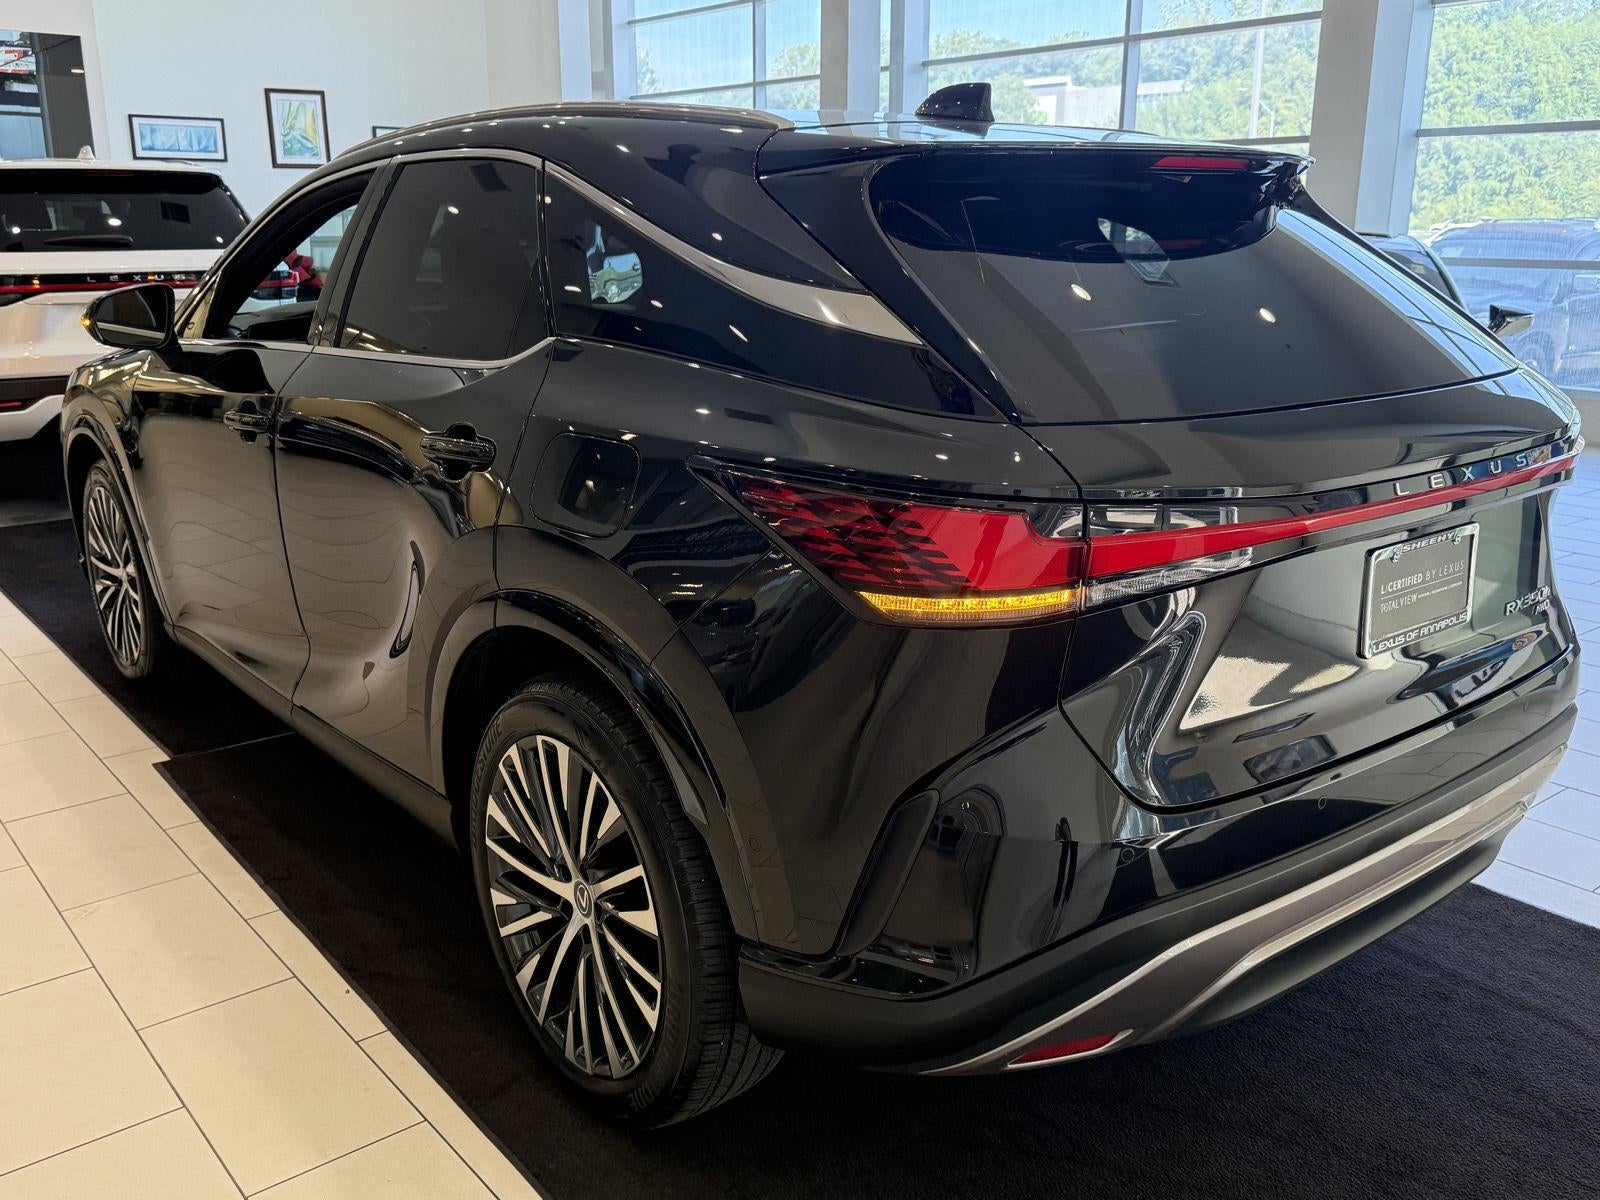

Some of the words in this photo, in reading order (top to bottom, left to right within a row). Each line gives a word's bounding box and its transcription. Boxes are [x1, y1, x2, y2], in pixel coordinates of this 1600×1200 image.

[1394, 454, 1528, 497] LEXUS
[1401, 533, 1456, 552] SHEEHY
[1426, 568, 1437, 581] BY
[1439, 560, 1464, 576] LEXUS
[1380, 599, 1399, 614] TOTAL
[1400, 592, 1418, 608] VIEW
[1373, 635, 1405, 653] LEXUS
[1406, 630, 1418, 642] OF
[1419, 612, 1468, 635] ANNAPOLIS
